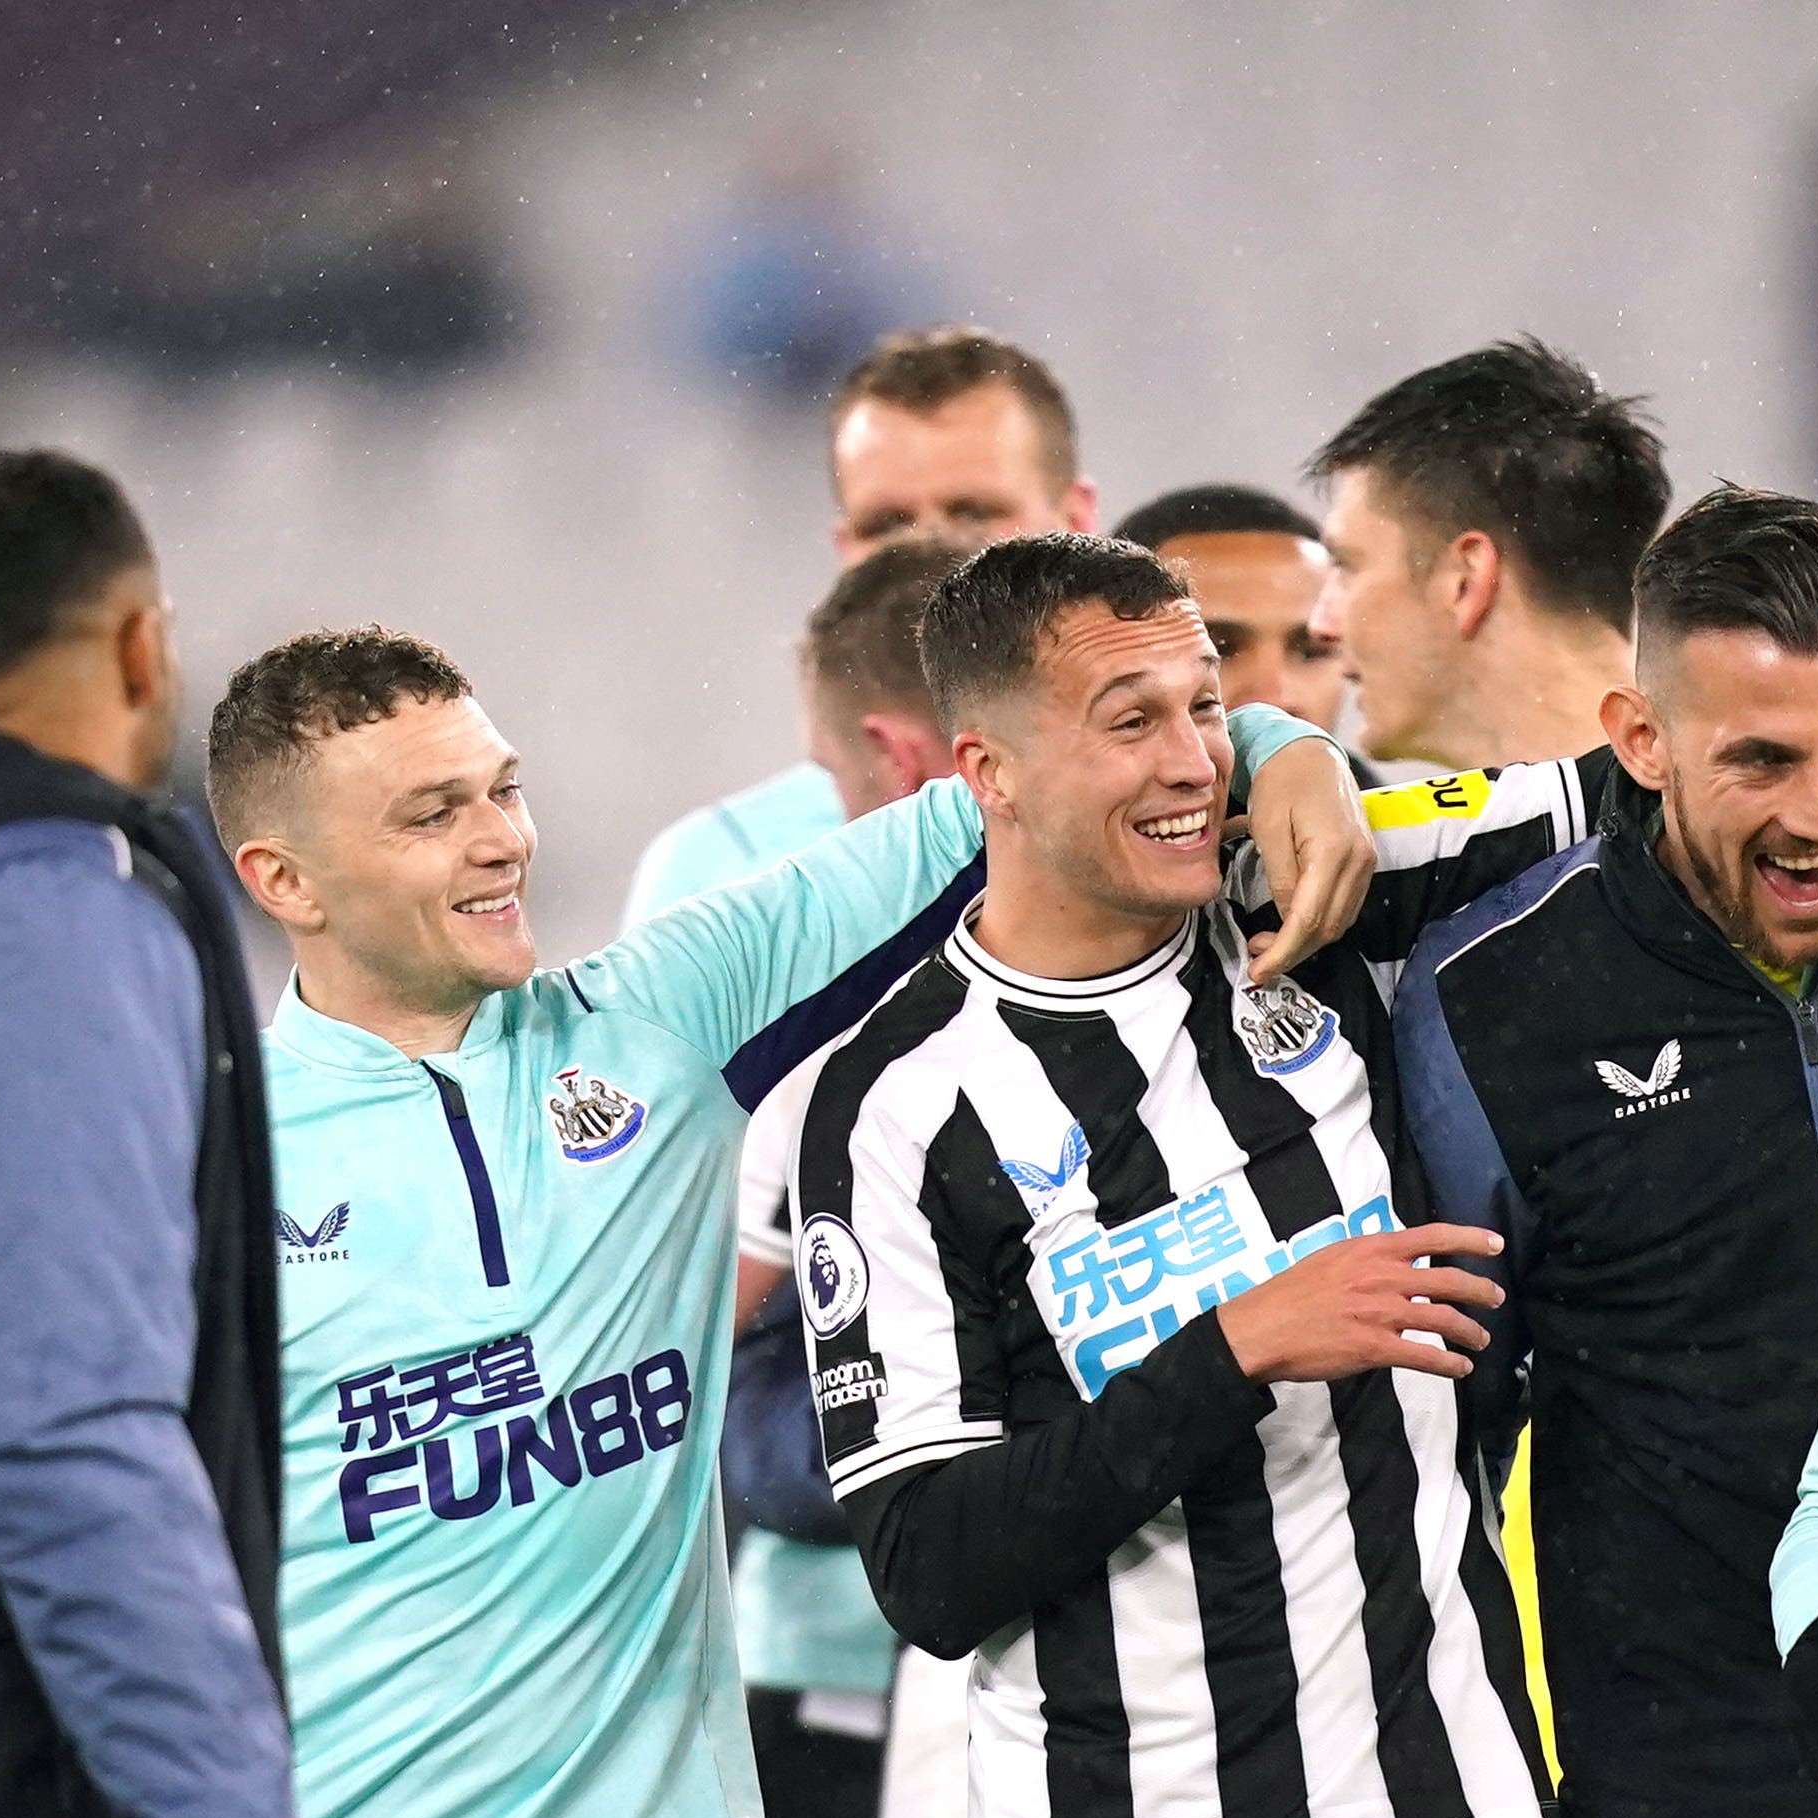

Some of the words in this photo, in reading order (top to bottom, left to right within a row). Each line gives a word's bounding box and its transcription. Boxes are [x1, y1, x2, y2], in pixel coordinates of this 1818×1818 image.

[1614, 1088, 1691, 1119] CASTORE
[1047, 1185, 1248, 1328] 乐天堂
[338, 1332, 546, 1453] 乐天堂
[822, 1360, 875, 1390] room
[339, 1348, 692, 1544] FUN88
